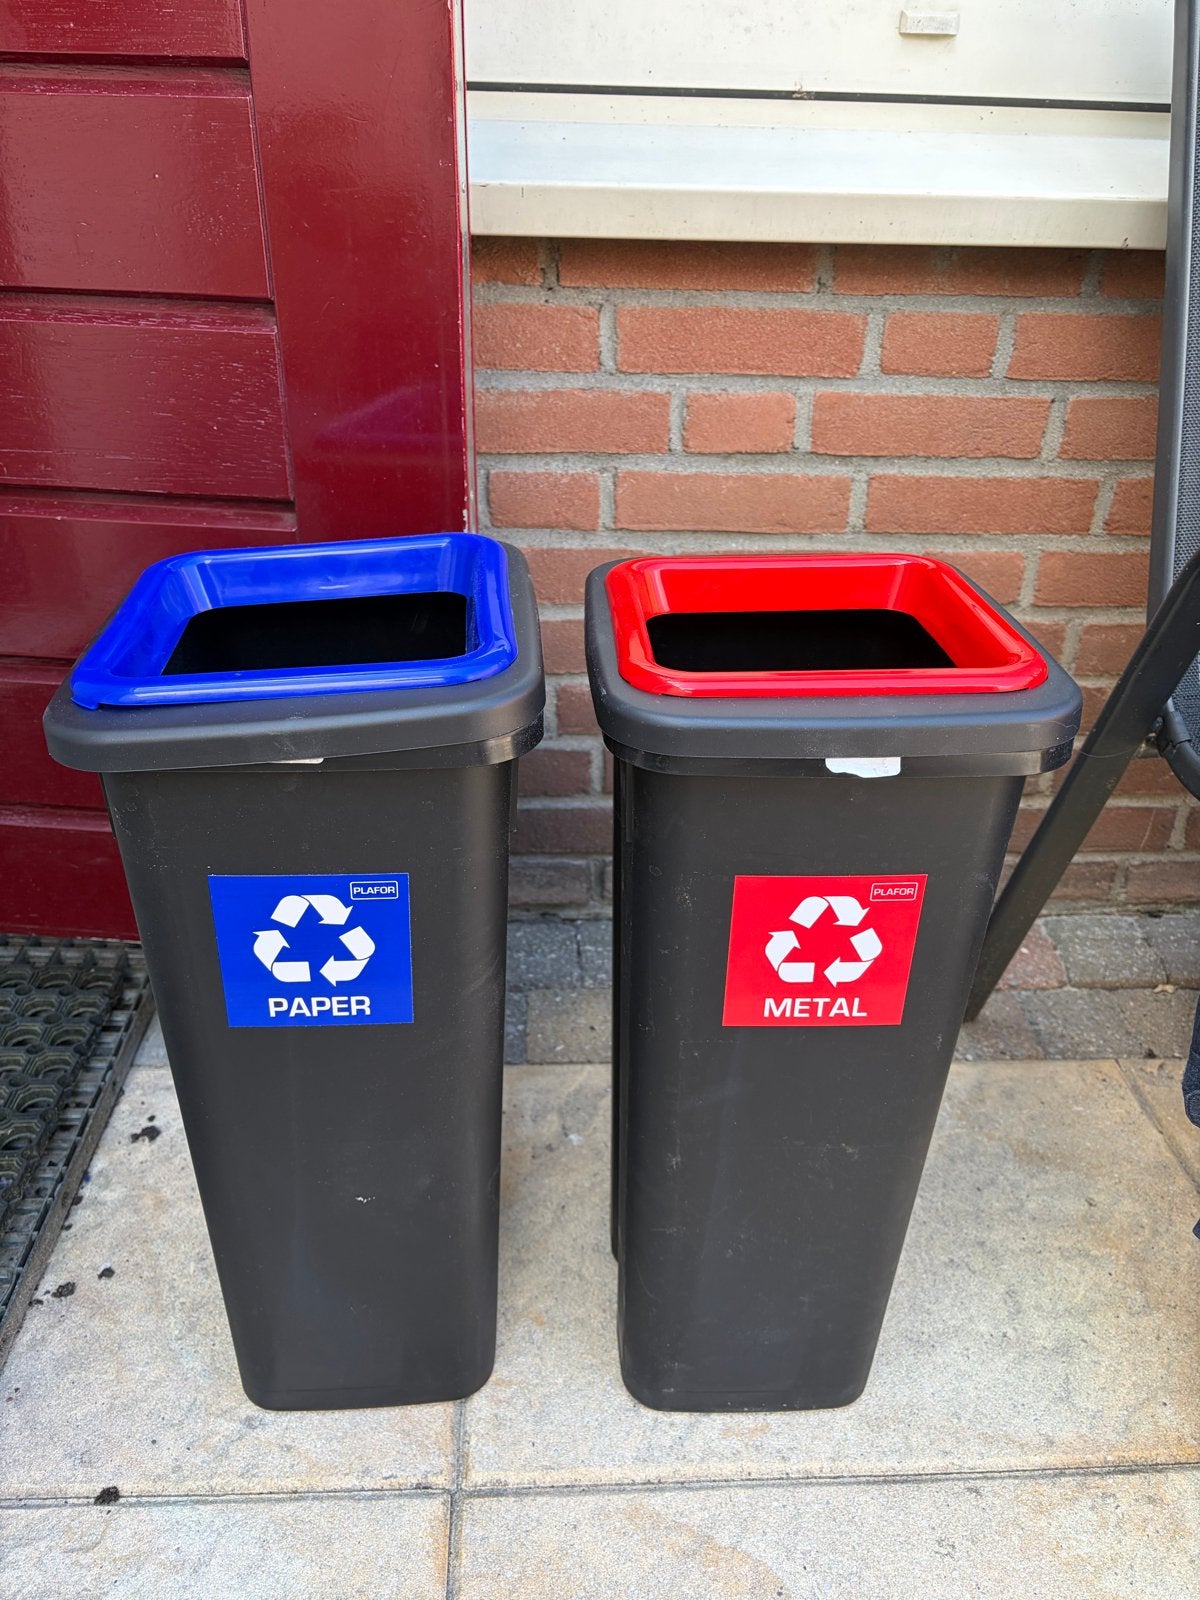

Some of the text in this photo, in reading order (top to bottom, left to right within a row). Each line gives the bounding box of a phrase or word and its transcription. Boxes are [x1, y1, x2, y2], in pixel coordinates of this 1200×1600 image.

[353, 886, 396, 895] PLAFOR
[873, 887, 915, 896] PLAFOR
[268, 996, 371, 1017] PAPER
[763, 997, 868, 1018] METAL
